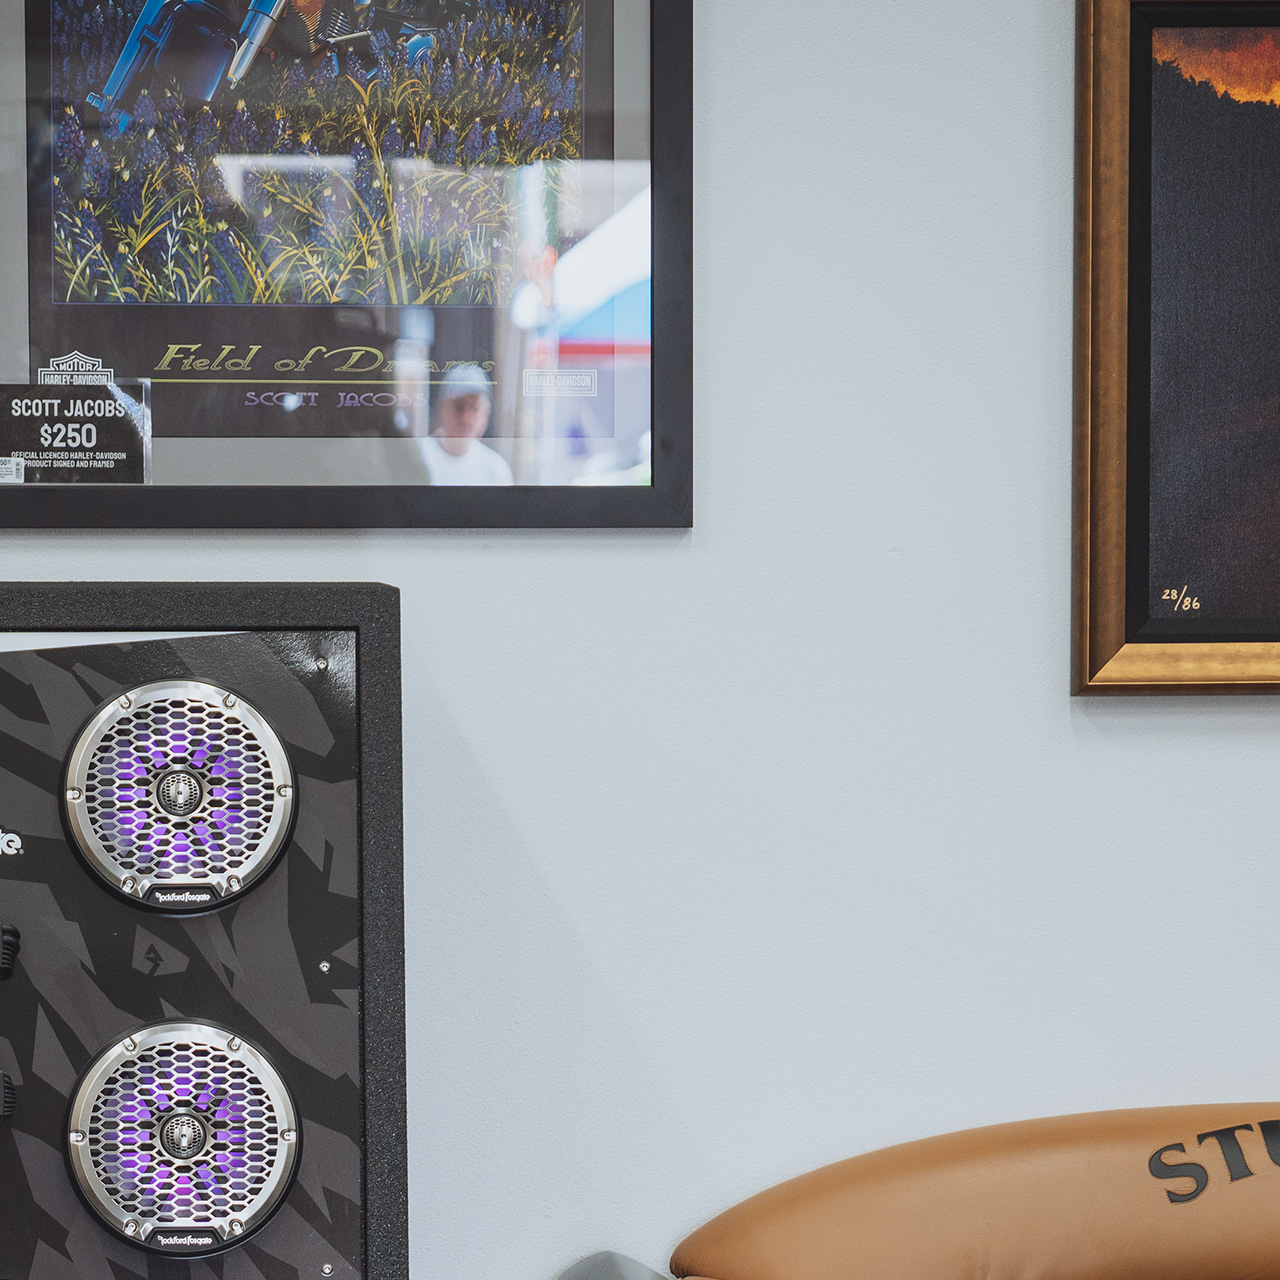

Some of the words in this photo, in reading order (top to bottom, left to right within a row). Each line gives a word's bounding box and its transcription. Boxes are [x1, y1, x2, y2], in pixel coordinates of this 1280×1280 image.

[59, 359, 94, 371] MOTOR
[154, 343, 262, 372] Field
[274, 346, 326, 372] of
[324, 344, 496, 373] Dreams
[44, 374, 107, 385] HARLEY-DAVIDSON
[528, 375, 592, 386] HARLEY-DAVIDSON
[245, 391, 318, 407] SCOTT
[336, 391, 429, 408] JACOBS
[11, 399, 61, 417] SCOTT
[64, 399, 126, 417] JACOBS
[40, 423, 97, 448] $250
[11, 451, 38, 459] OFFICIAL
[39, 451, 69, 459] LICENCED
[70, 452, 127, 460] HARLEY-DAVIDSON
[24, 460, 52, 468] PRODUCT
[52, 460, 75, 468] SIGNED
[1161, 585, 1201, 611] 28/86
